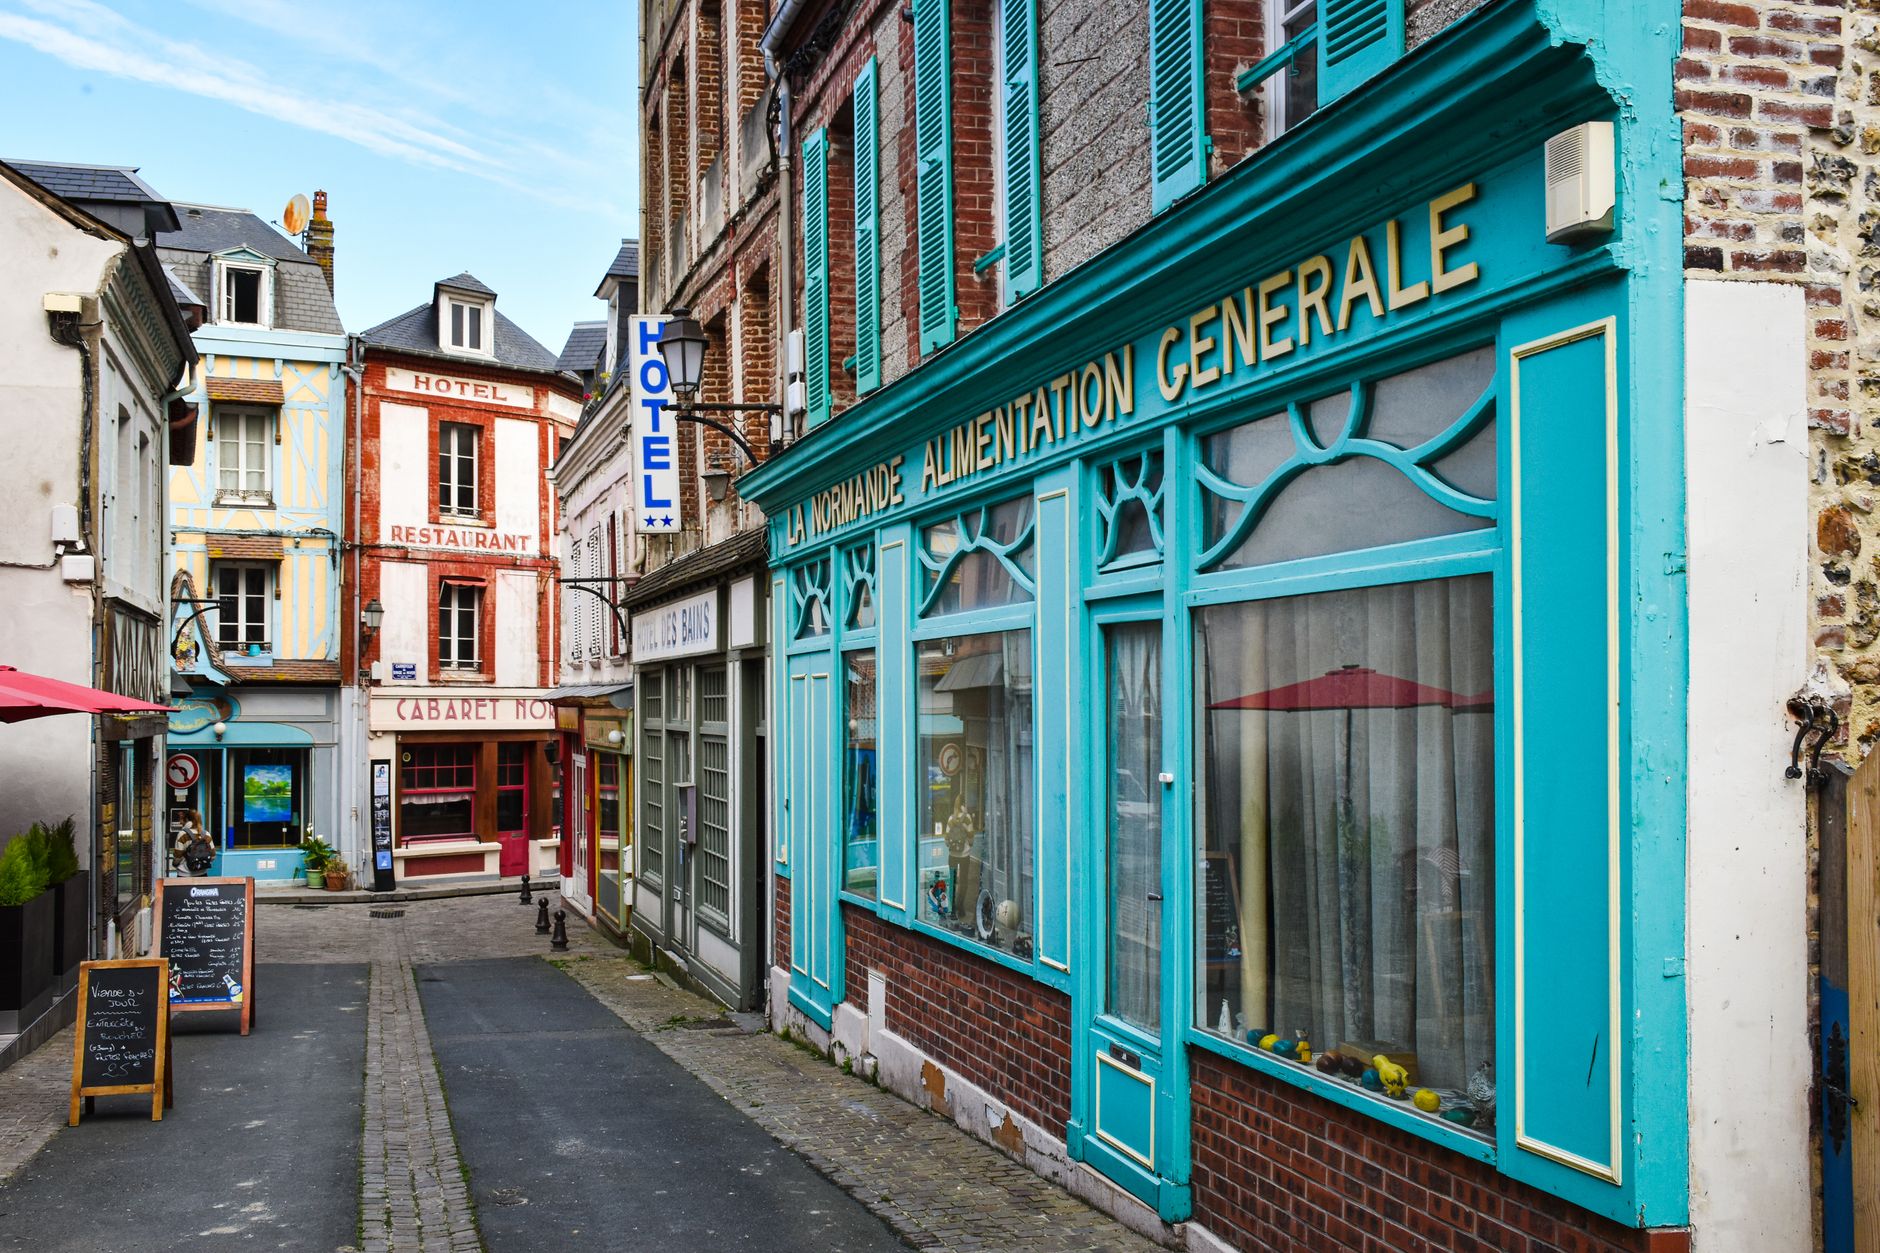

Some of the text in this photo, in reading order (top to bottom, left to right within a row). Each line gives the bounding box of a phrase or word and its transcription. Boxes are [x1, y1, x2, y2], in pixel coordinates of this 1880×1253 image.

[787, 182, 1478, 546] LA NORMANDE ALIMENTATION GENERALE
[414, 375, 507, 401] HOTEL
[639, 321, 672, 508] HOTEL
[391, 525, 531, 551] RESTAURANT
[661, 611, 677, 649] DES
[682, 600, 709, 644] BAINS
[397, 699, 500, 720] CABARET
